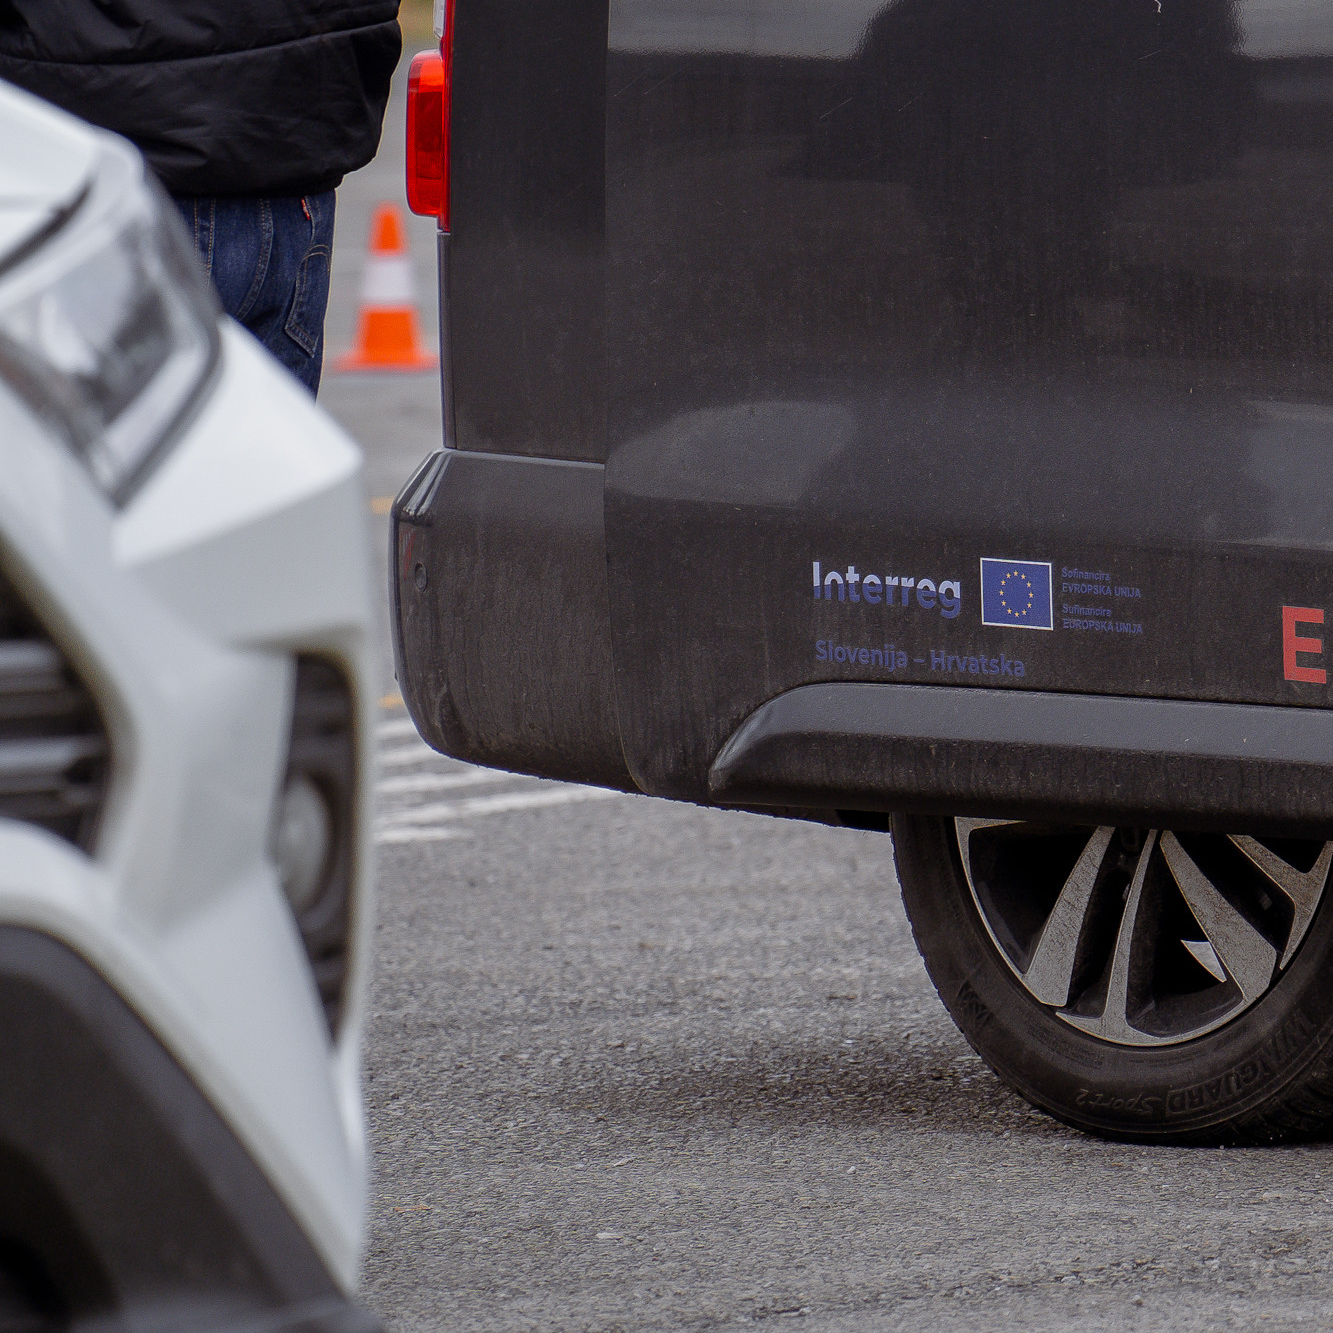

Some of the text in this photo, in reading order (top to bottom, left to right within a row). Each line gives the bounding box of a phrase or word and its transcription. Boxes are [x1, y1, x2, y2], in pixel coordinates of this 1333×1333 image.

[1061, 567, 1111, 581] Sofinancira
[812, 561, 961, 618] Interreg
[1062, 582, 1142, 598] EVROPSKA UNIJA
[1115, 621, 1144, 634] UNIJA
[815, 640, 908, 672] Slovenija
[930, 650, 1025, 677] Hrvatska
